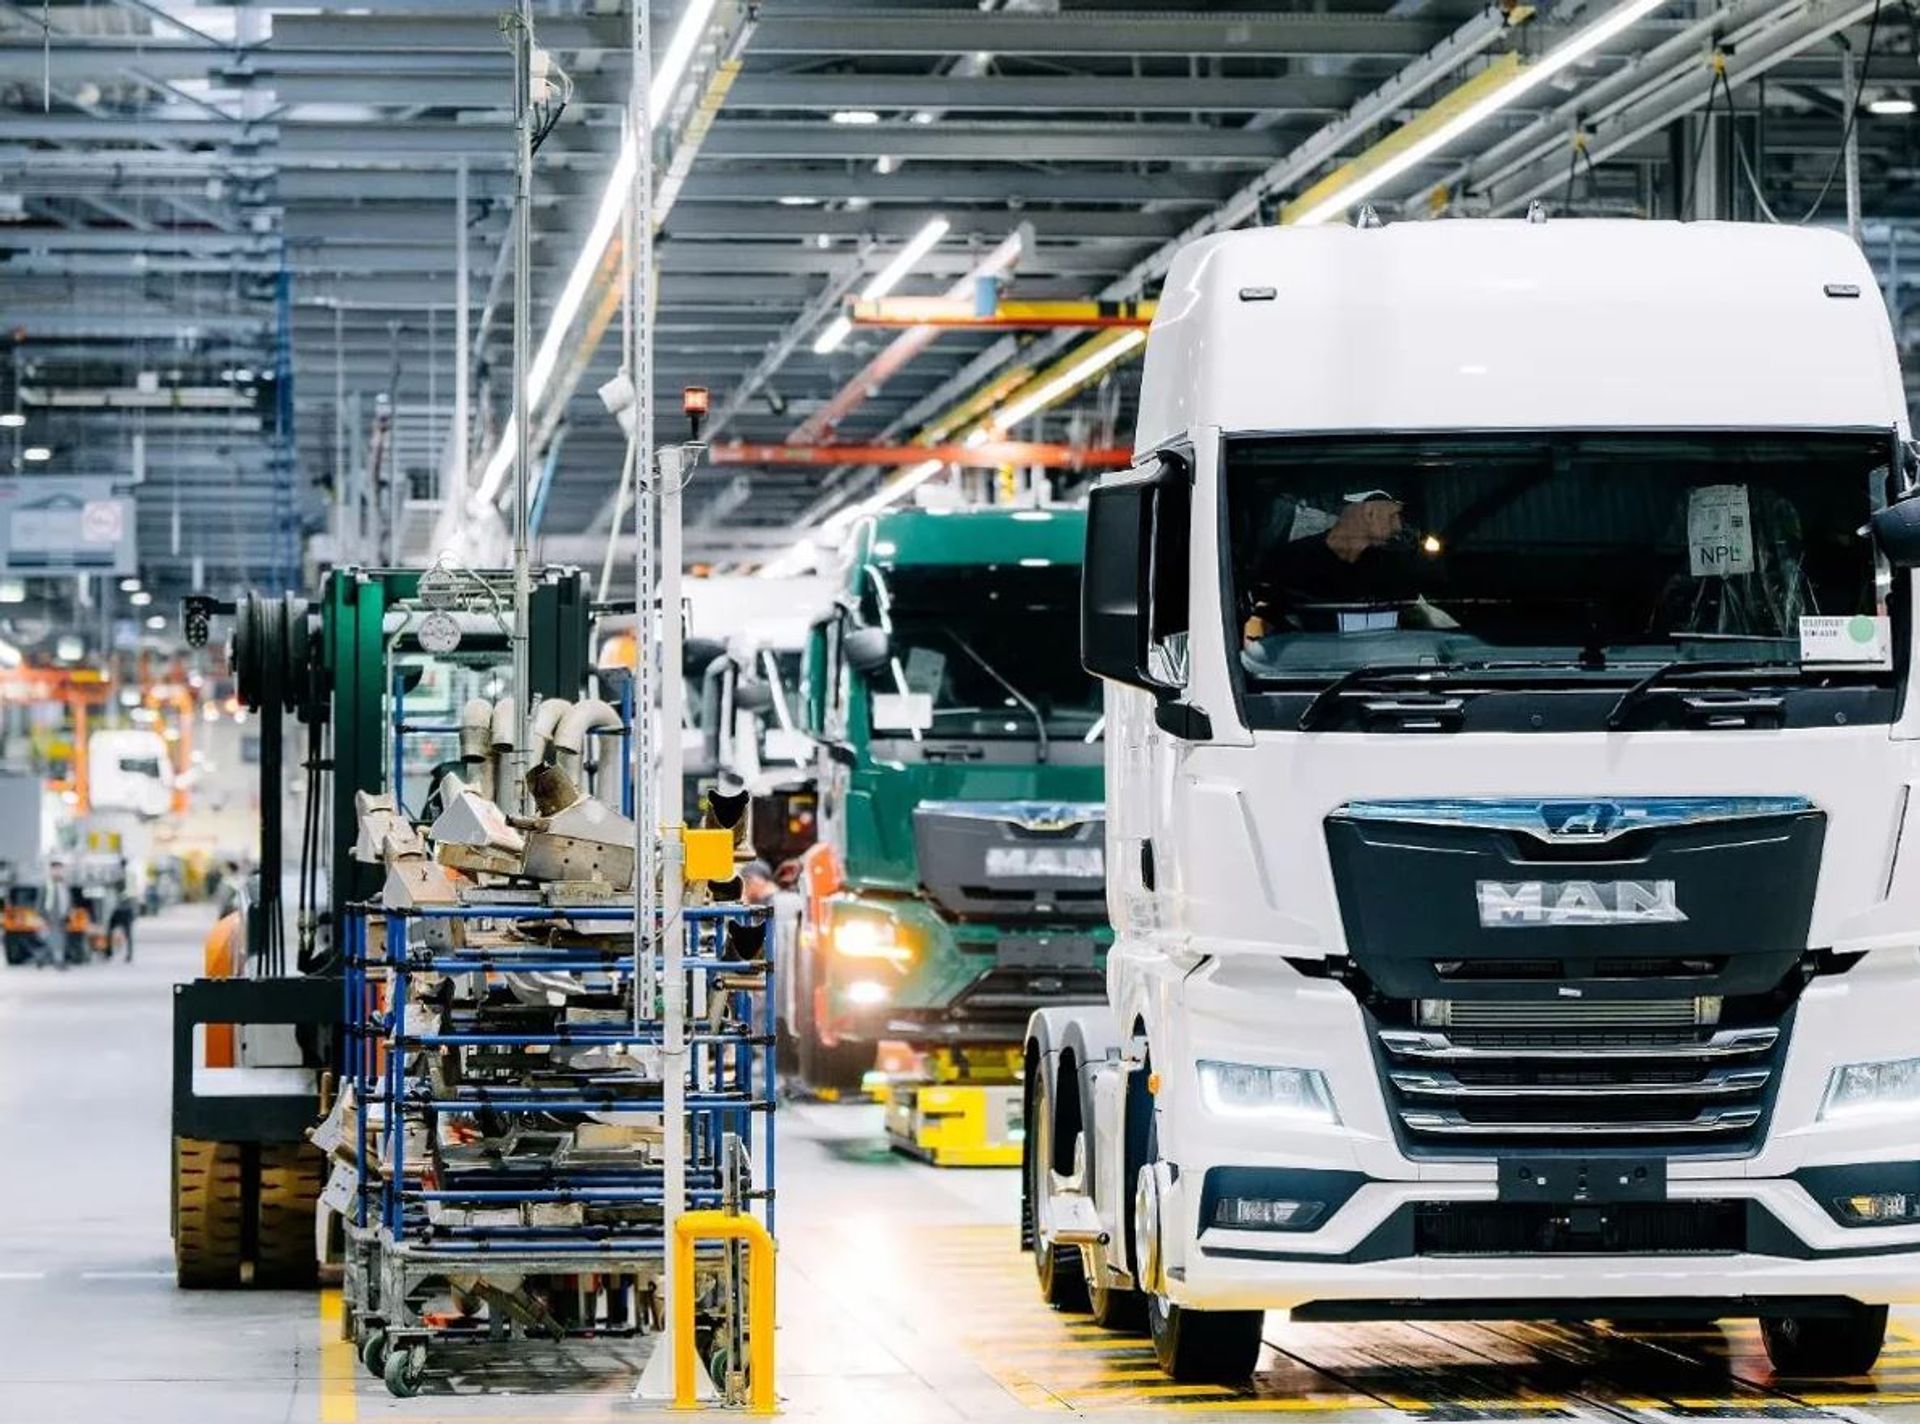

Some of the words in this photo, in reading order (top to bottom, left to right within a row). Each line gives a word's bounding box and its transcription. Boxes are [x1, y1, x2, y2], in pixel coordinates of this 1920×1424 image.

[1700, 545, 1742, 565] NPL
[985, 848, 1104, 877] MAN
[1482, 881, 1676, 921] MAN
